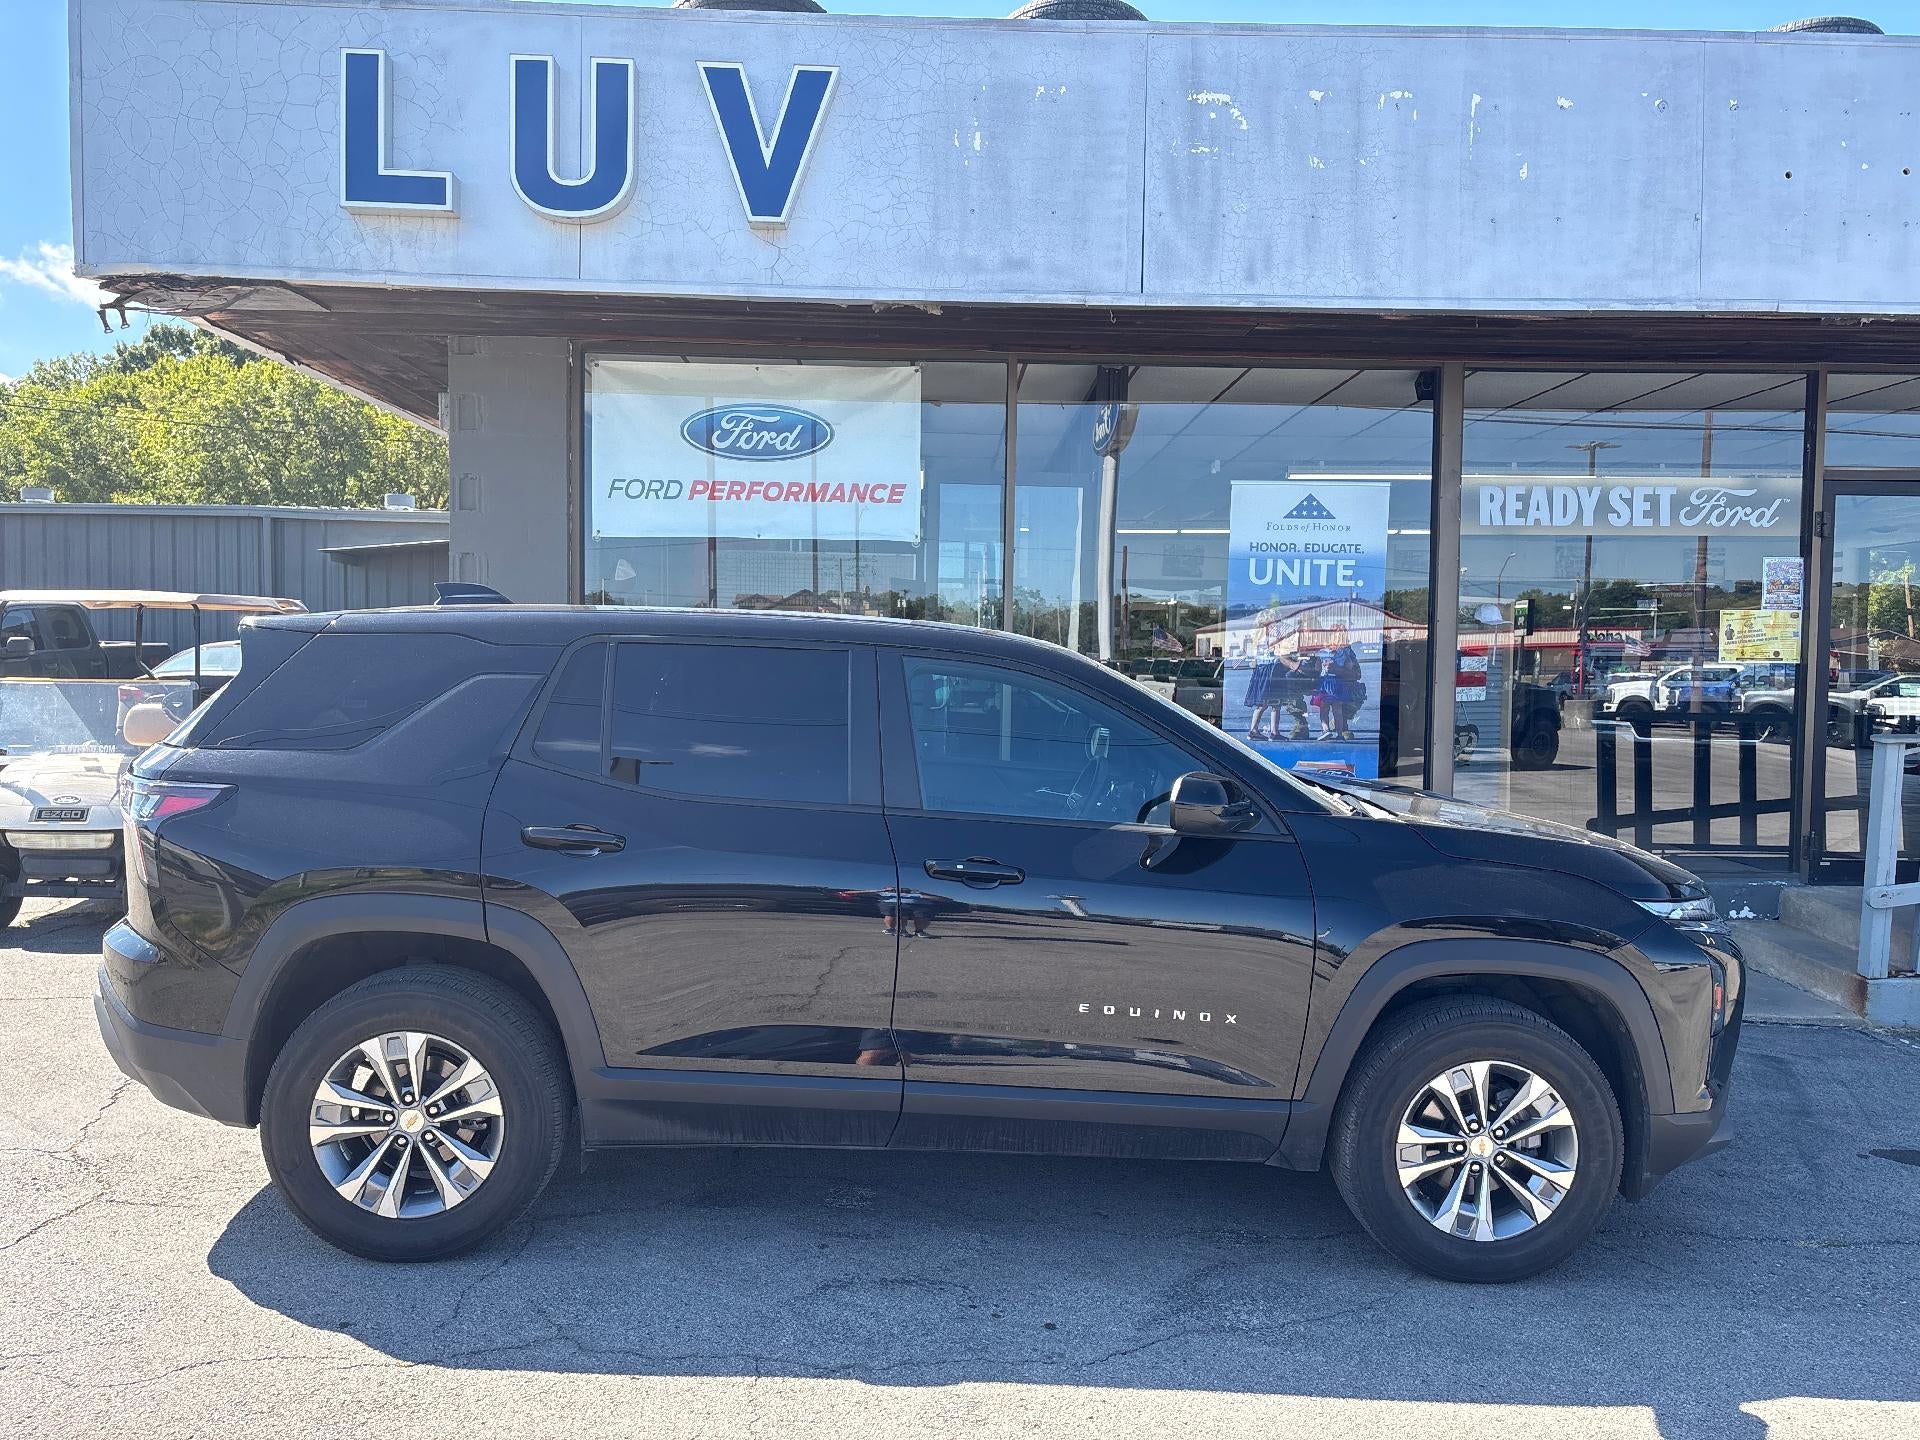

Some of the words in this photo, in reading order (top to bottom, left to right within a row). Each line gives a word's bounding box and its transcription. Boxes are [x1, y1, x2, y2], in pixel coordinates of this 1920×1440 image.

[340, 47, 840, 228] LUV
[711, 414, 803, 452] Ford
[607, 478, 683, 501] FORD
[688, 480, 907, 505] PERFORMANCE
[1479, 485, 1601, 527] READY
[1608, 486, 1677, 527] SET
[1678, 487, 1780, 529] Ford
[1301, 524, 1310, 532] of
[1250, 542, 1300, 553] HONOR.
[1304, 543, 1365, 554] EDUCATE.
[1248, 558, 1364, 587] UNITE.
[1079, 1003, 1237, 1024] EQUINOX
